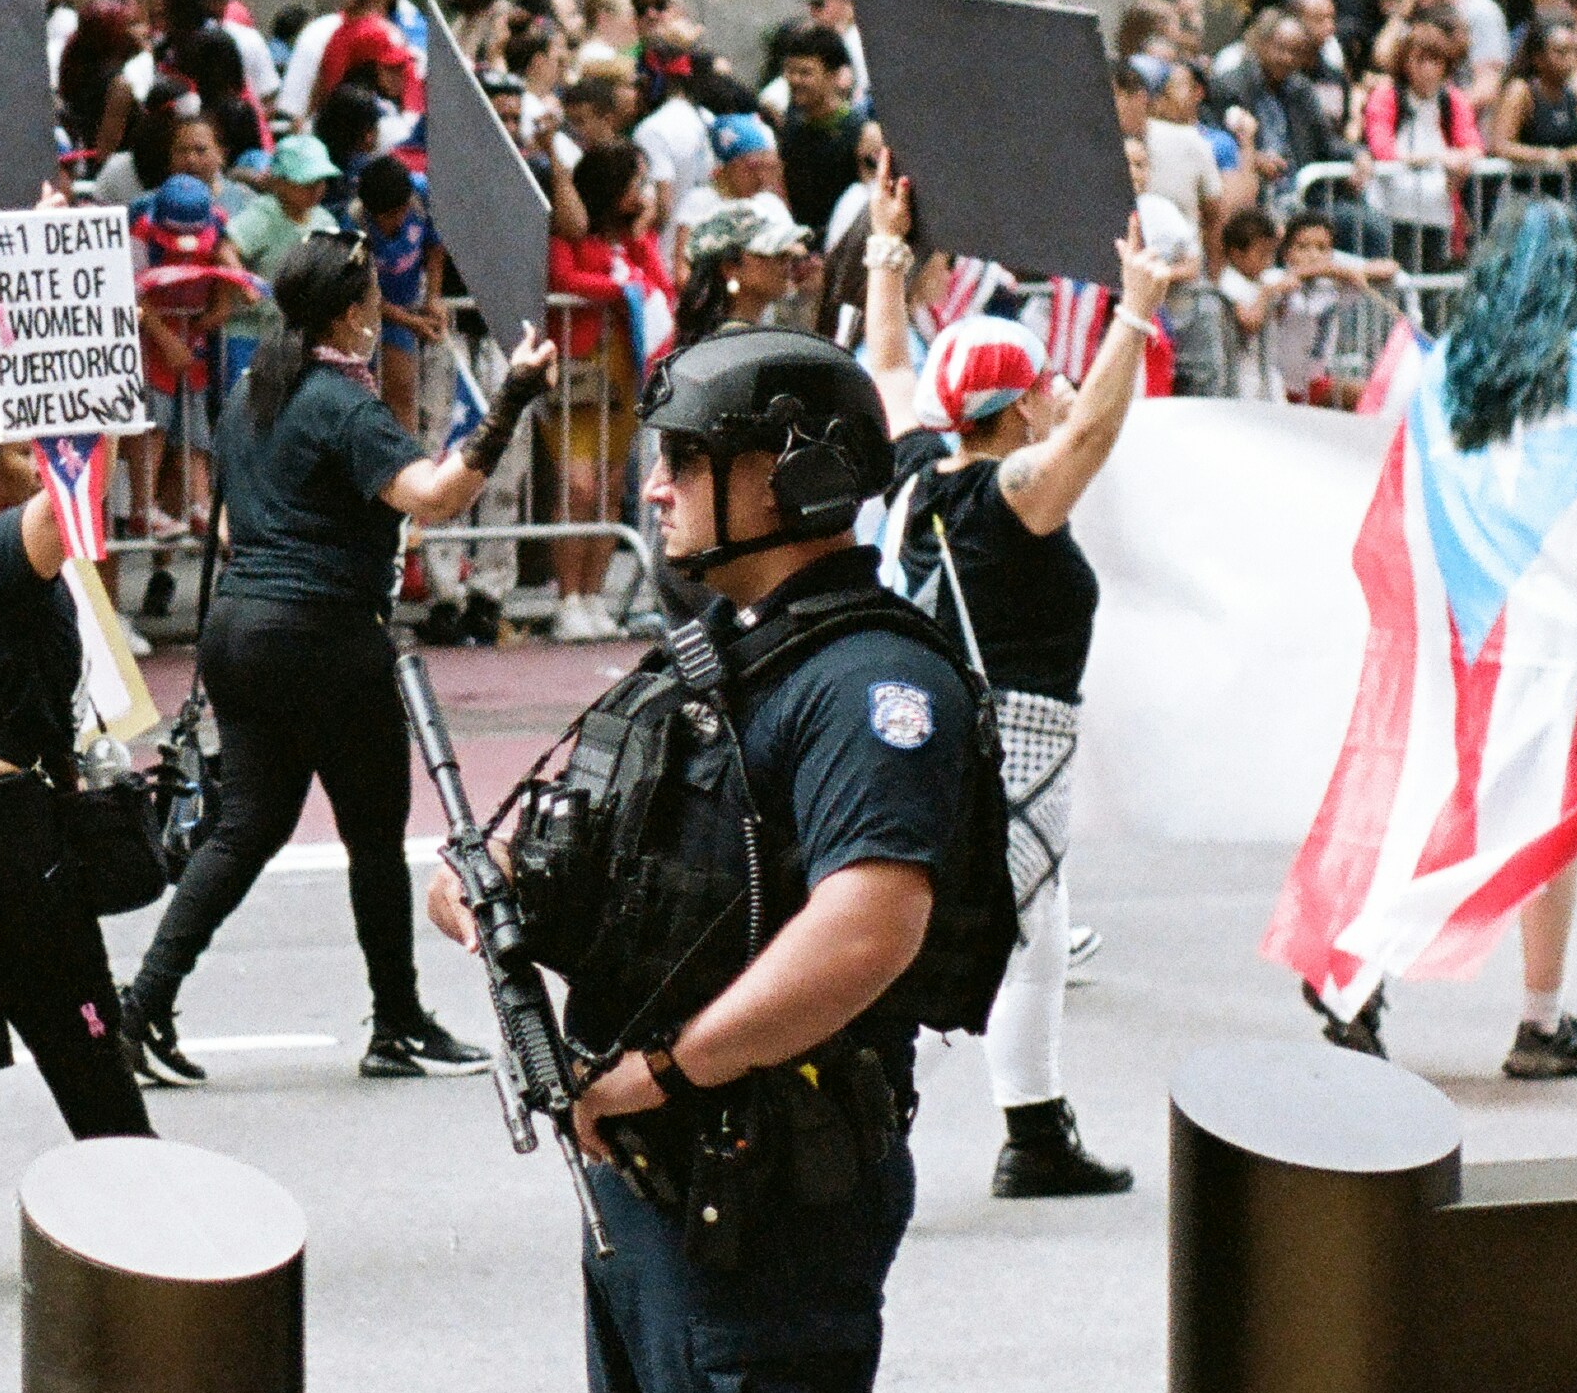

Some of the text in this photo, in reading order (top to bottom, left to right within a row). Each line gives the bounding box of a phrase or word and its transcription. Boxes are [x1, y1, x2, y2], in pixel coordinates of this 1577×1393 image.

[44, 217, 124, 256] DEATH
[73, 266, 106, 300] OF
[8, 305, 137, 341] WOMEN IN
[1, 375, 146, 432] SAVE US NOW
